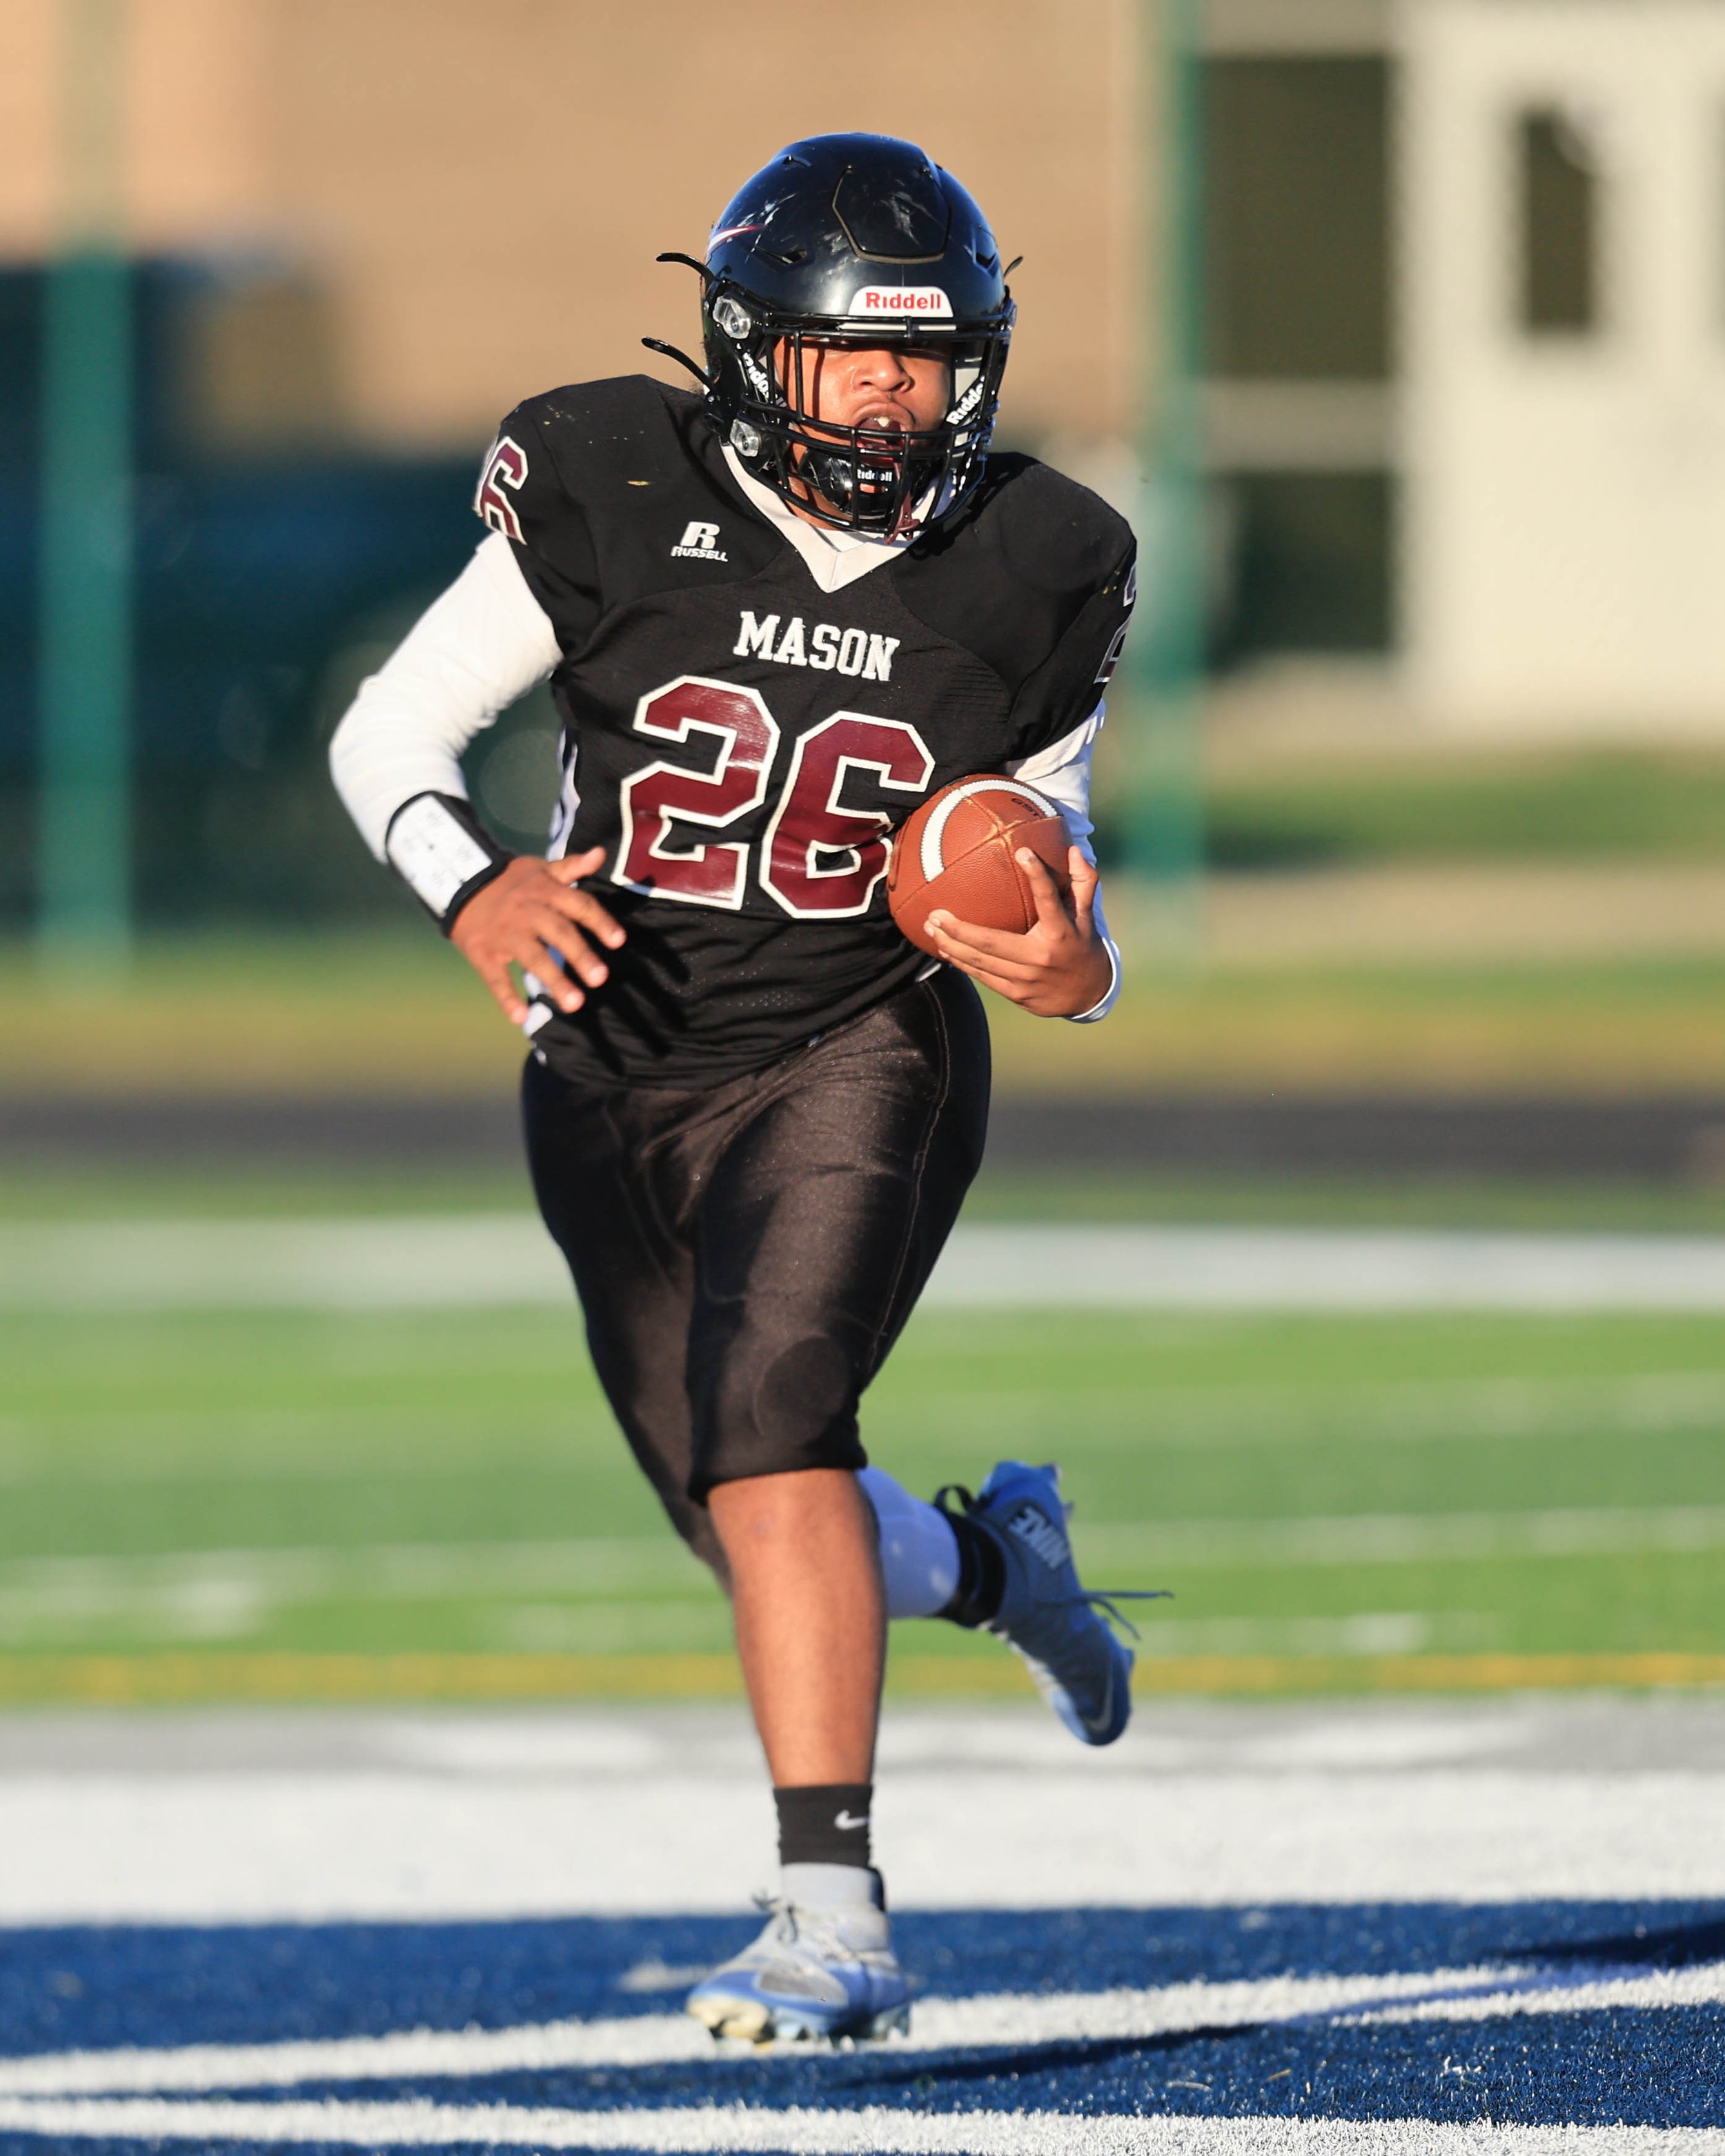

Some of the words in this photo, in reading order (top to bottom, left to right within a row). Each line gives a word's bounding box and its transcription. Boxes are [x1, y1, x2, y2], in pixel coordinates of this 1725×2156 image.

[865, 293, 941, 309] Riddell
[473, 436, 529, 545] 6
[671, 546, 729, 562] RUSSELL
[680, 521, 720, 549] R
[733, 611, 900, 682] MASON
[610, 675, 936, 919] 26
[1008, 1506, 1069, 1570] NIKE
